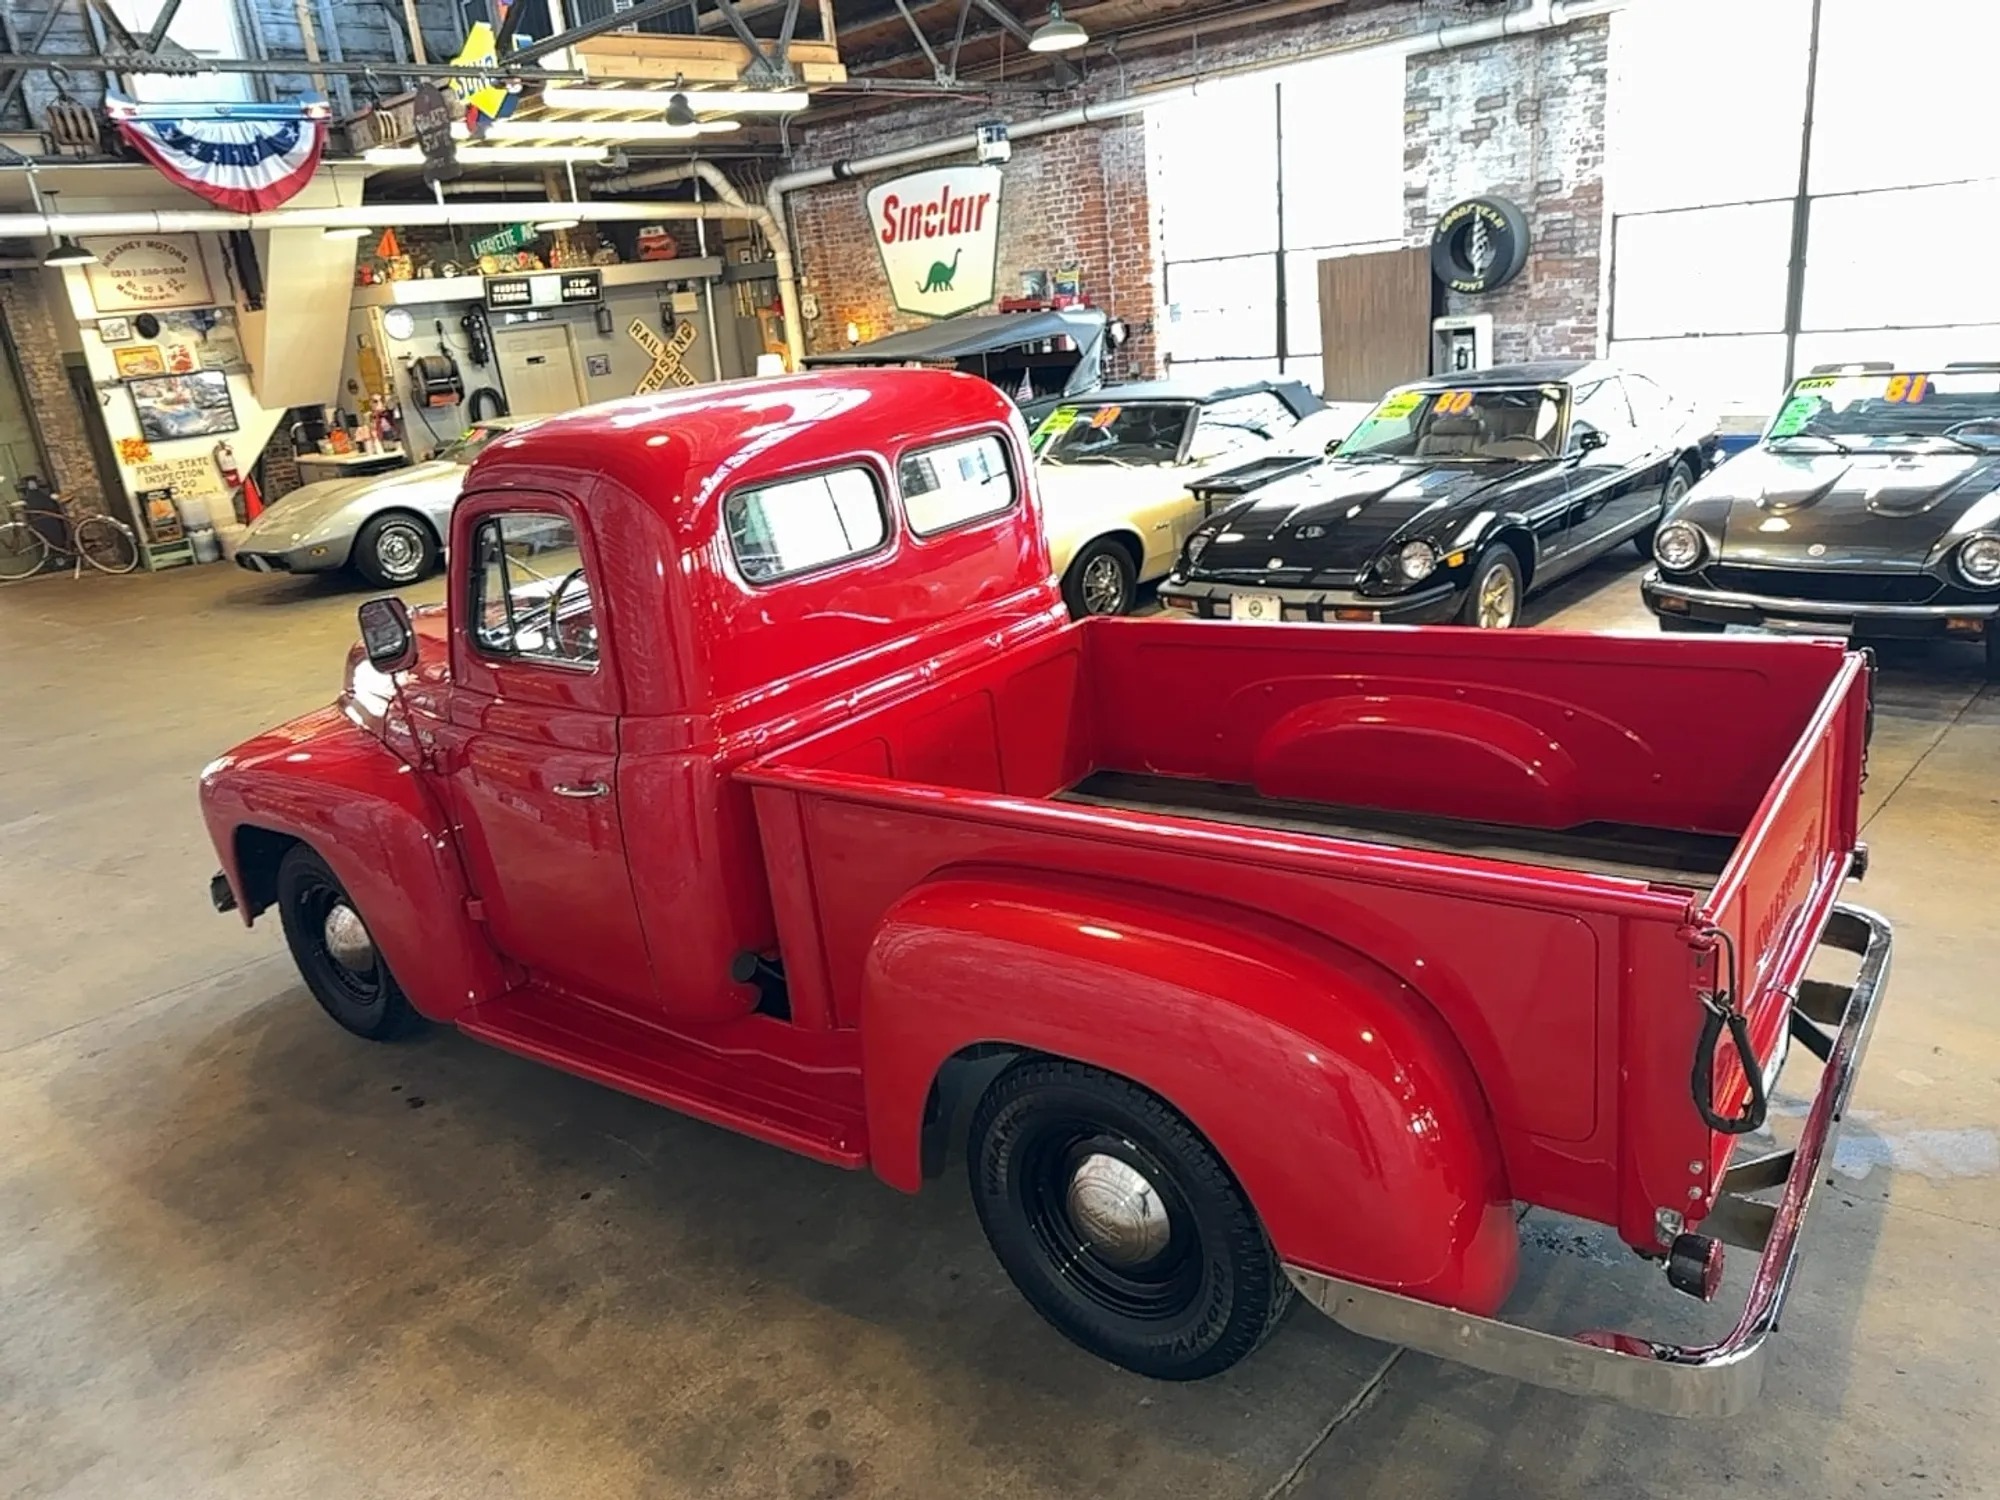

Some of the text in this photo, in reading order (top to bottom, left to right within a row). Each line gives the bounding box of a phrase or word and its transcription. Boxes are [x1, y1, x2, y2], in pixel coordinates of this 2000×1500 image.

[881, 184, 990, 245] Sinclair
[1440, 203, 1506, 233] GOODYEAR
[145, 240, 189, 263] MOTORS
[563, 286, 597, 297] STREET
[1451, 280, 1484, 292] EAGLE
[631, 322, 660, 357] RAIL
[1884, 374, 1928, 403] 81
[1434, 390, 1472, 415] 80
[178, 456, 209, 469] STATE
[145, 469, 205, 484] INSPECTION
